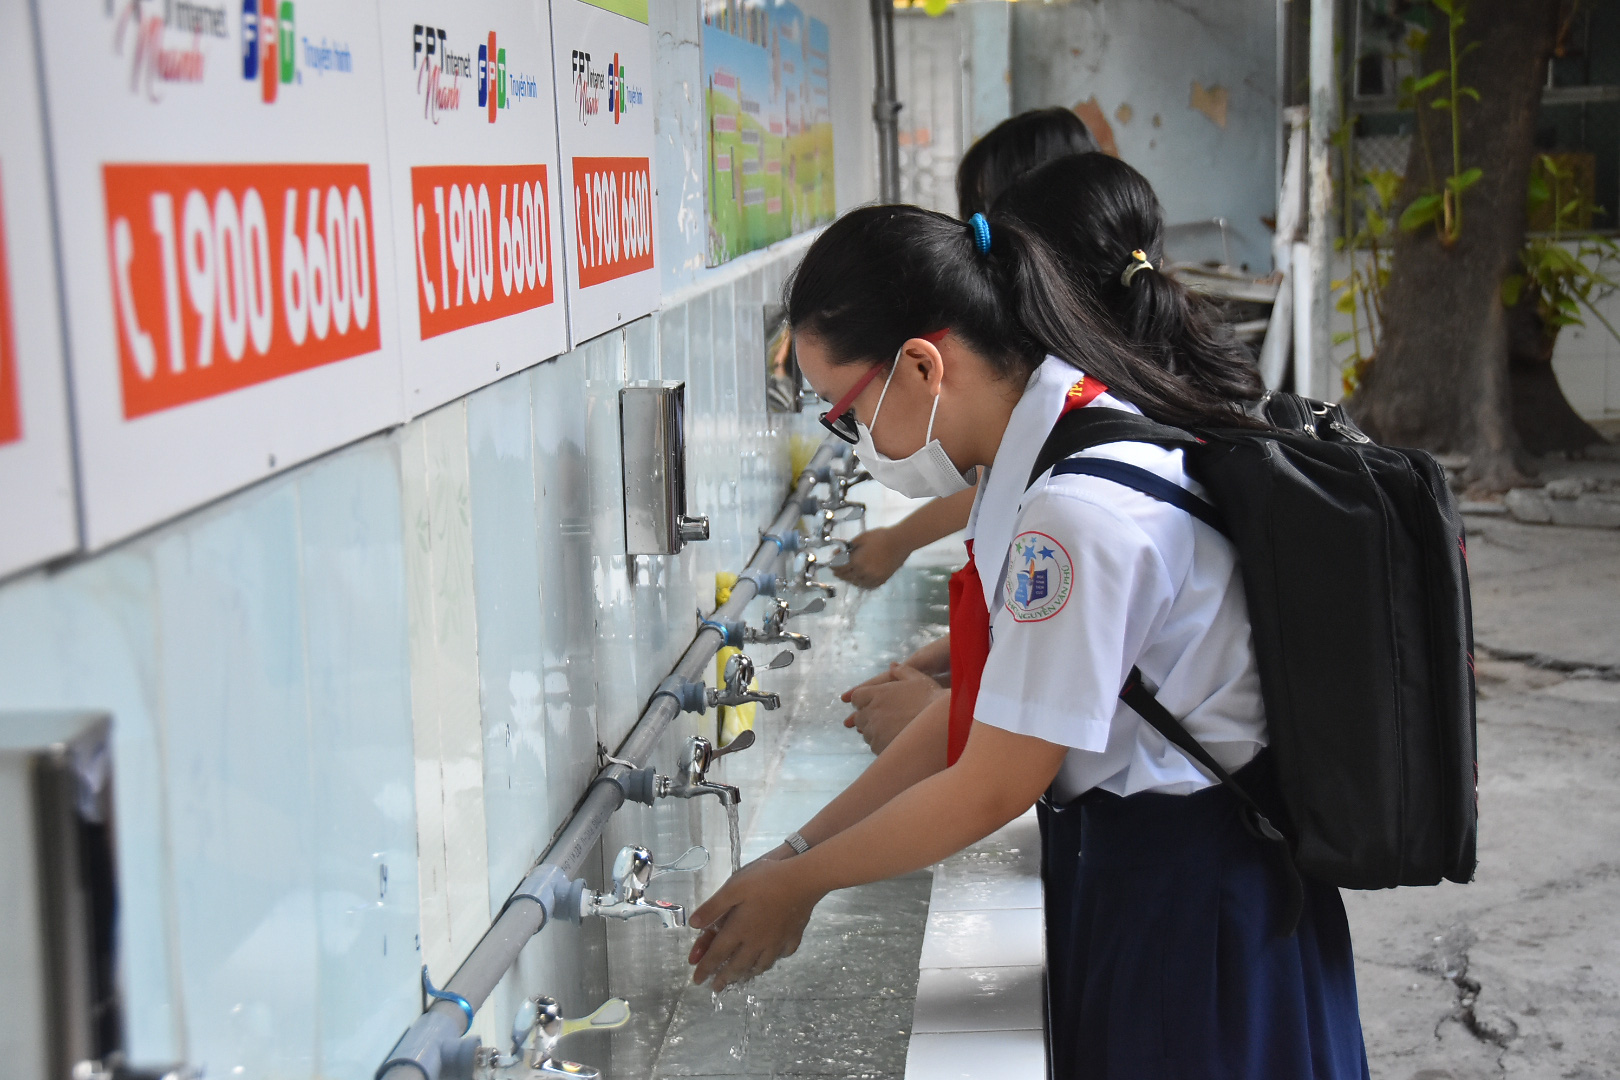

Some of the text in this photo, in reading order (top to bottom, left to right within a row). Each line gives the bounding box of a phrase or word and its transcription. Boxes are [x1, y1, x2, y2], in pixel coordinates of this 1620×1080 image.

[413, 24, 472, 79] FPT Internet
[572, 49, 606, 91] FPT Internet
[434, 180, 547, 310] 1900 6600
[585, 169, 650, 268] 1900 6600
[150, 184, 371, 375] 1900 6600
